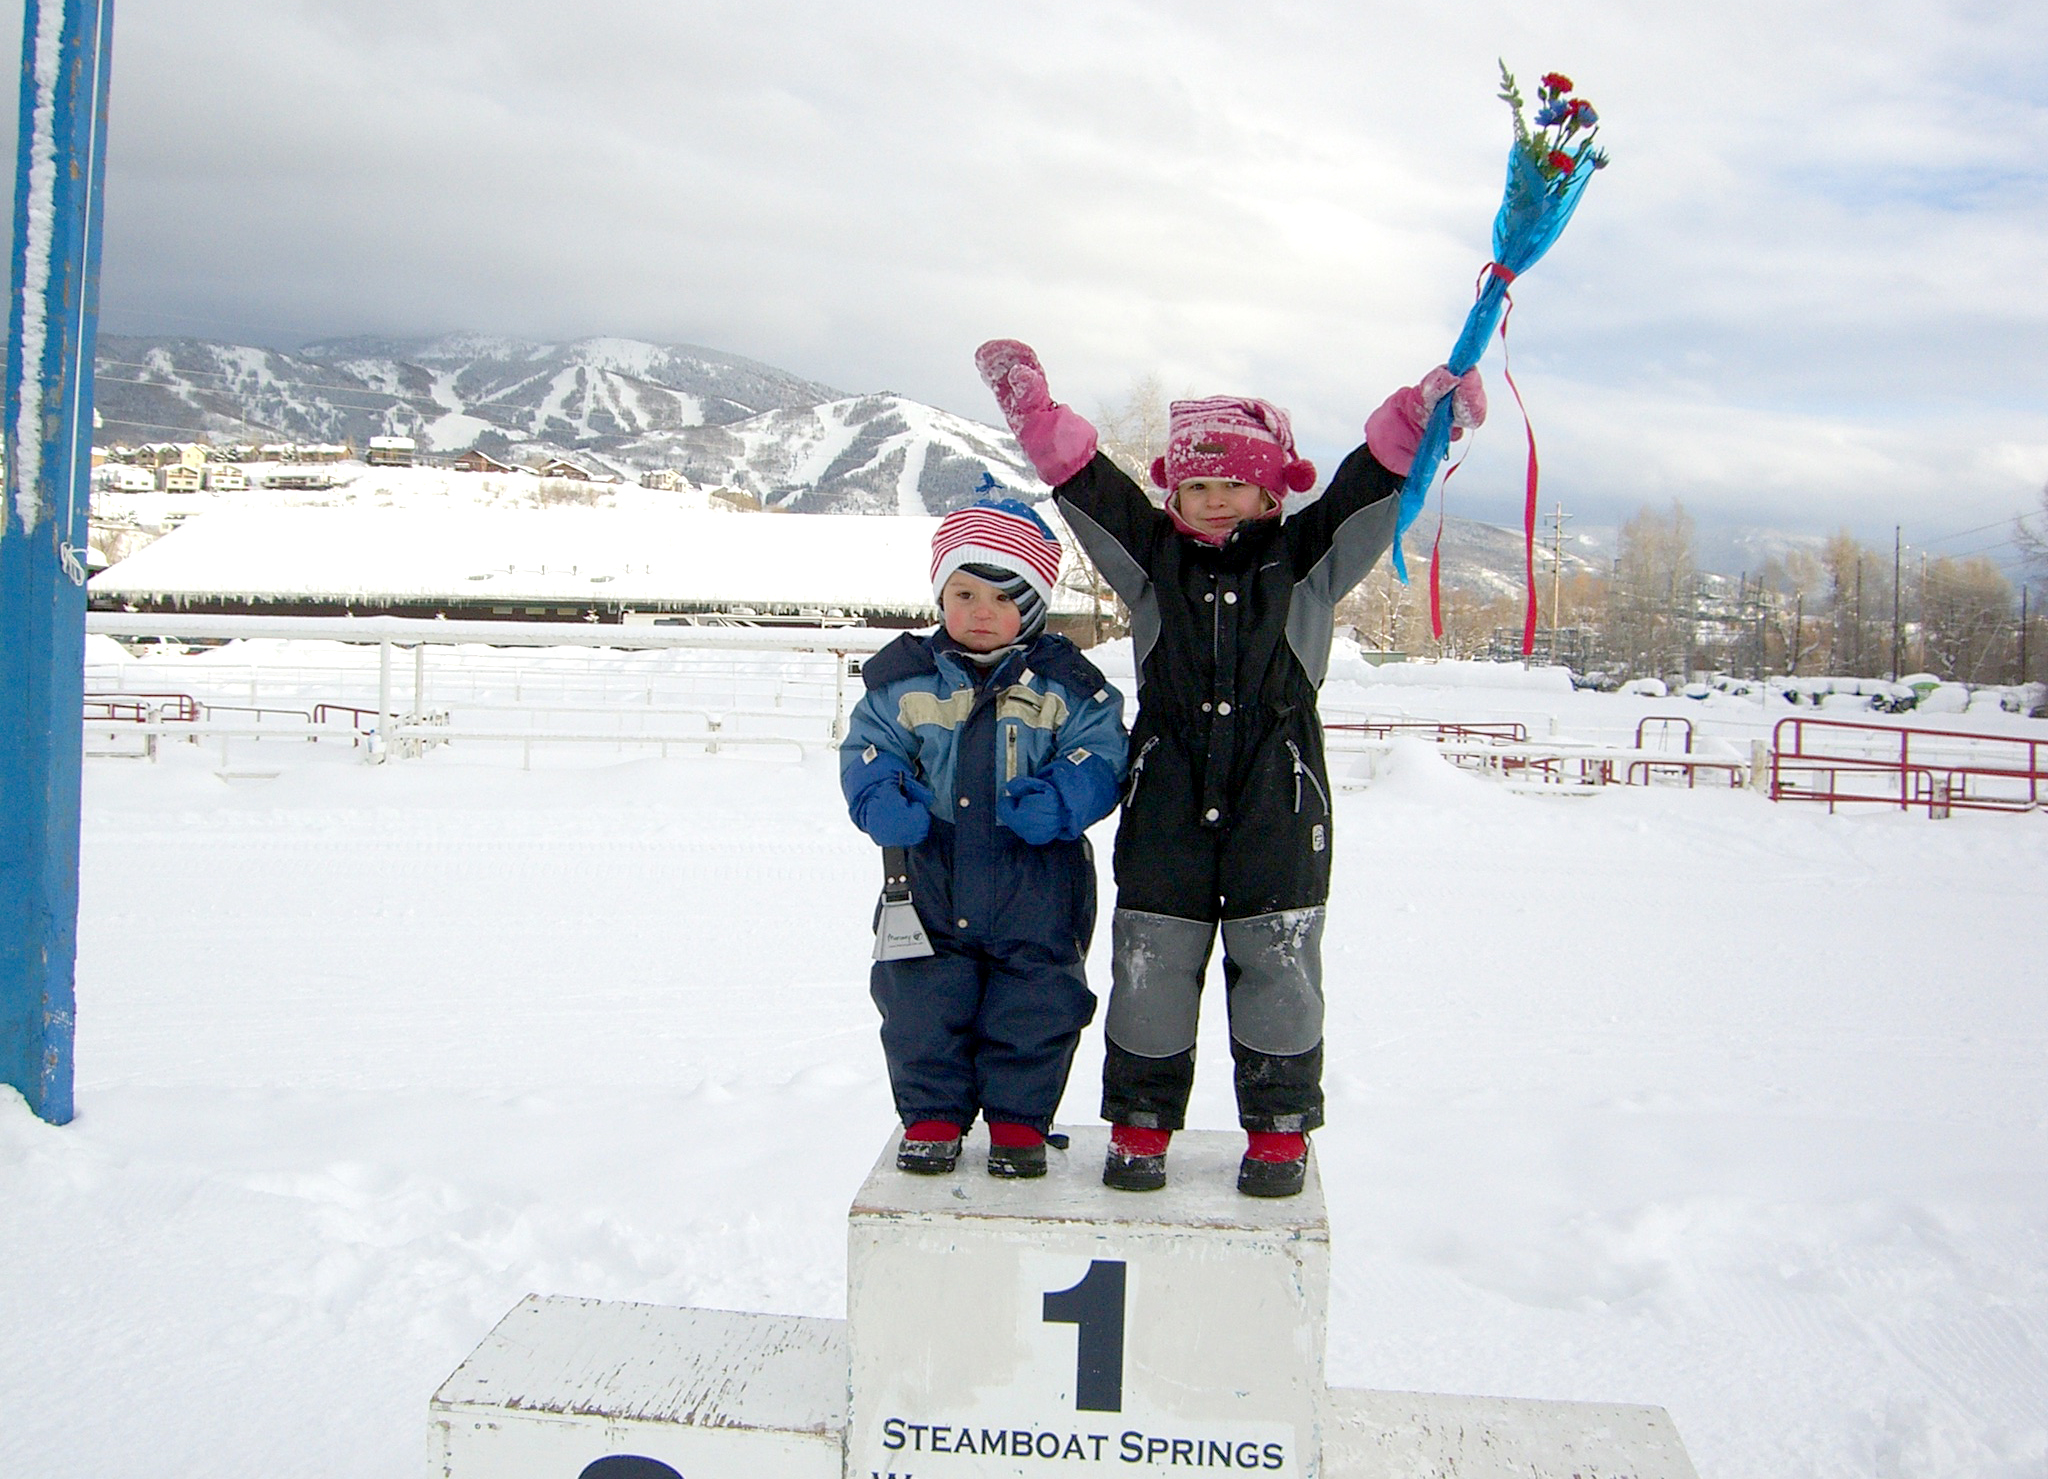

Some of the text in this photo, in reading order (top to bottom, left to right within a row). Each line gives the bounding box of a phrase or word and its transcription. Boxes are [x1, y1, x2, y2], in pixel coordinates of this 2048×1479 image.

[1043, 1260, 1126, 1413] 1
[883, 1418, 1284, 1470] STEAMBOAT SPRINGS
